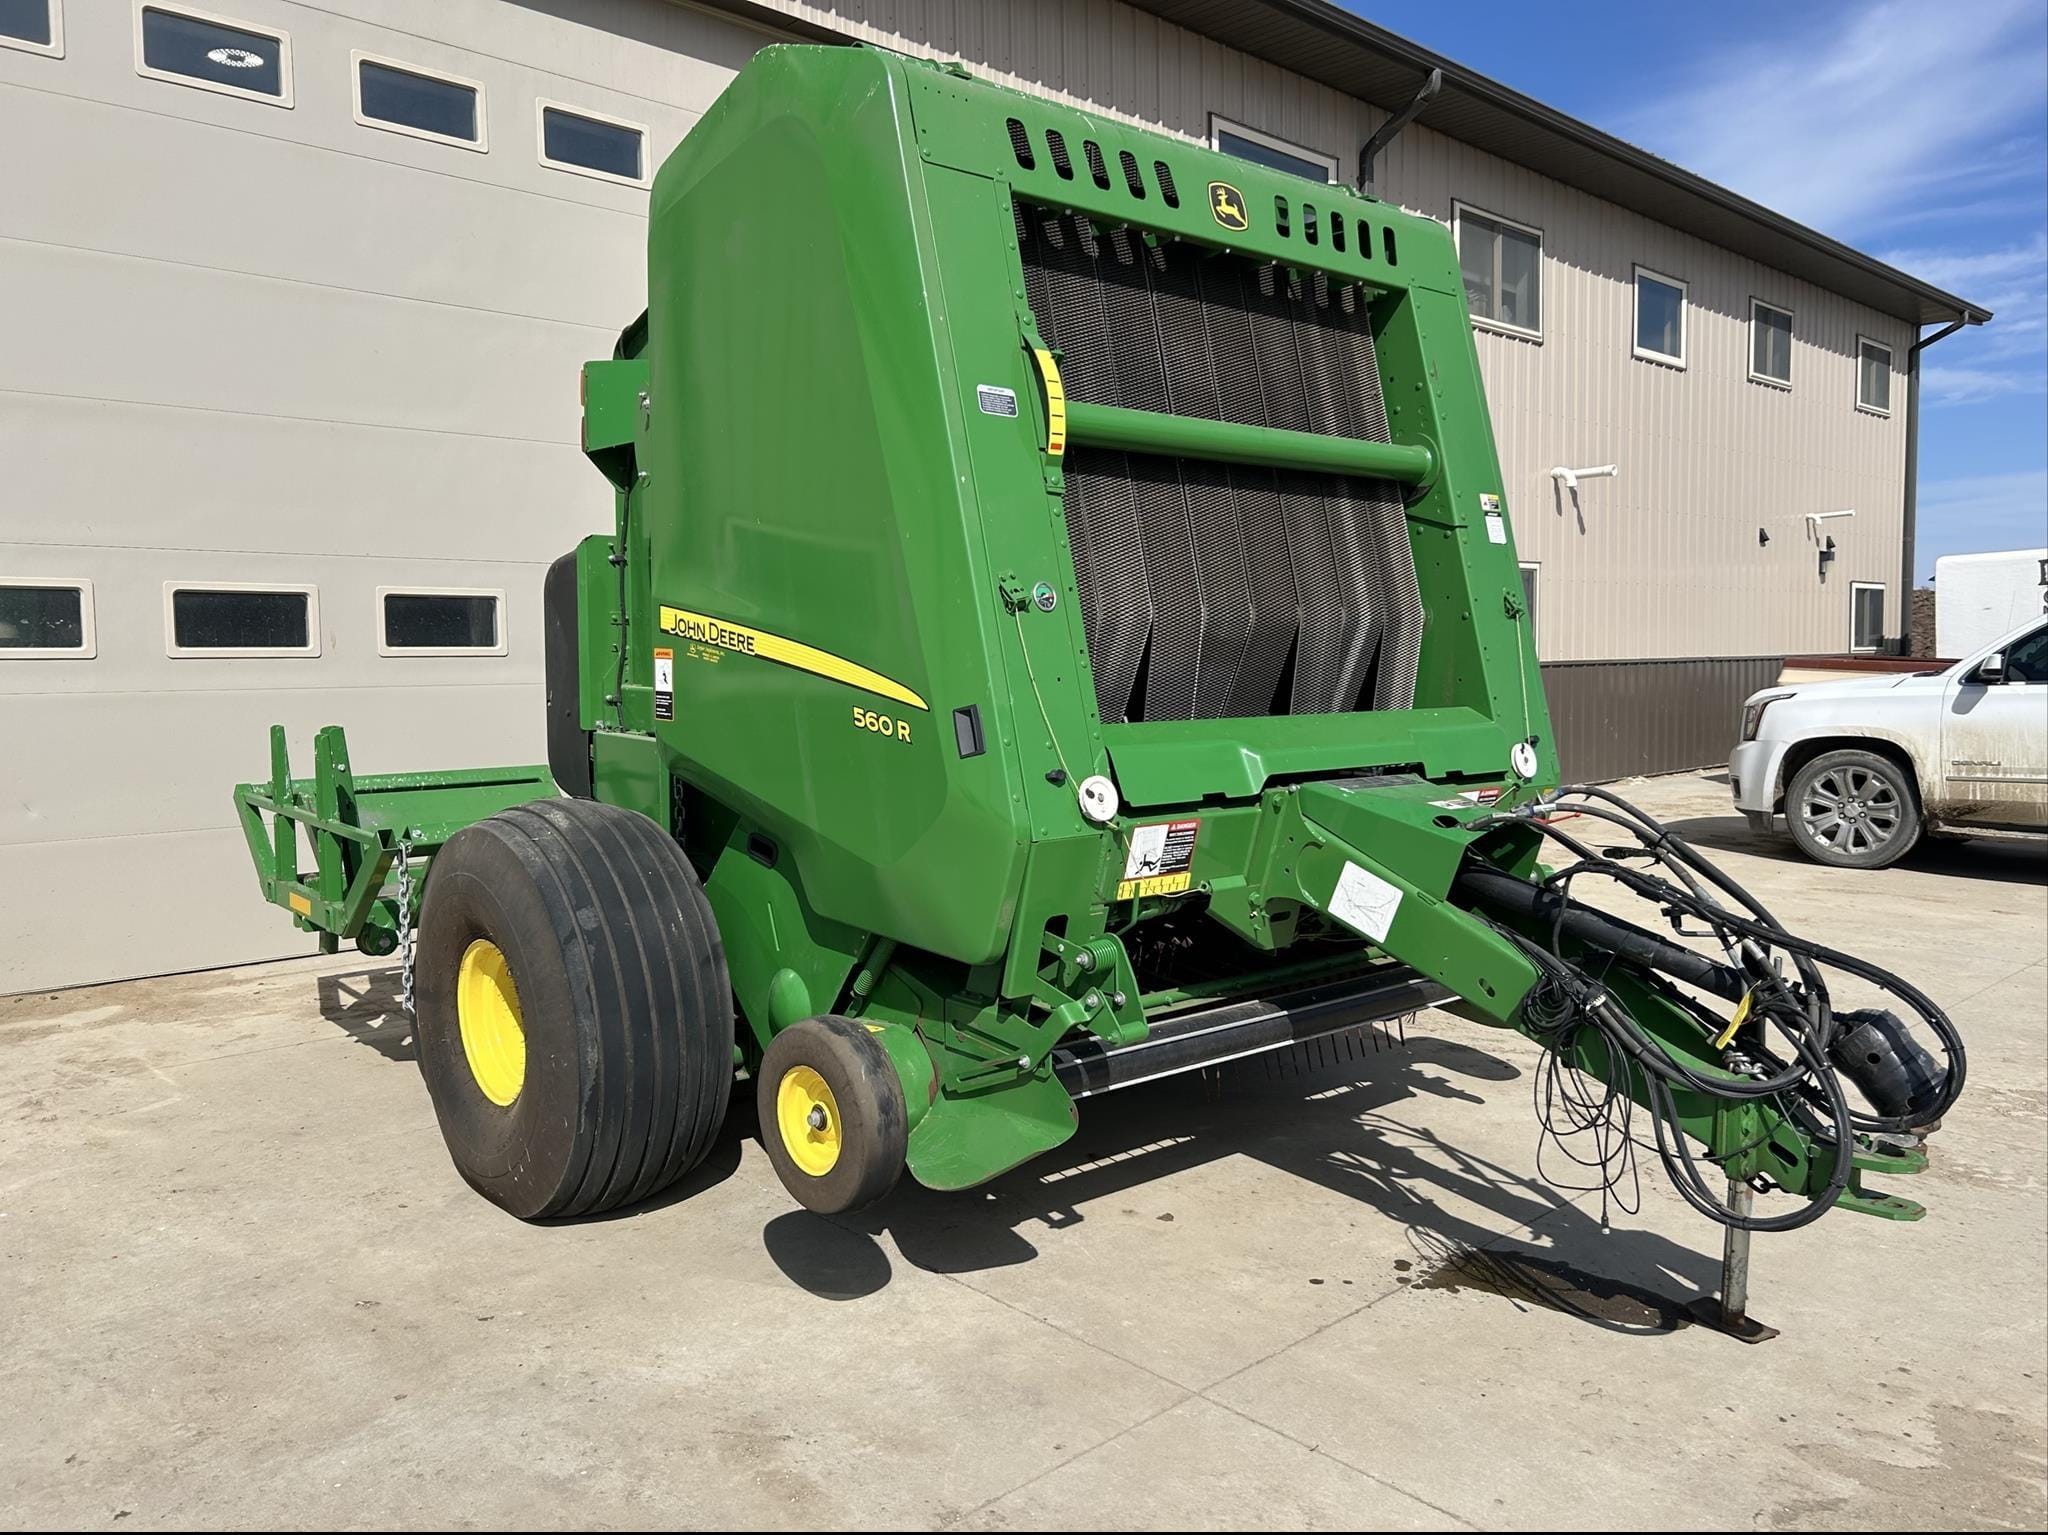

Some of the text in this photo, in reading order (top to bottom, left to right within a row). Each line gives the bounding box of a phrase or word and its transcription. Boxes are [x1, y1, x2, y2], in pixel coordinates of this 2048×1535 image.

[671, 614, 755, 652] JOHN DEERE
[853, 706, 912, 744] 560 R
